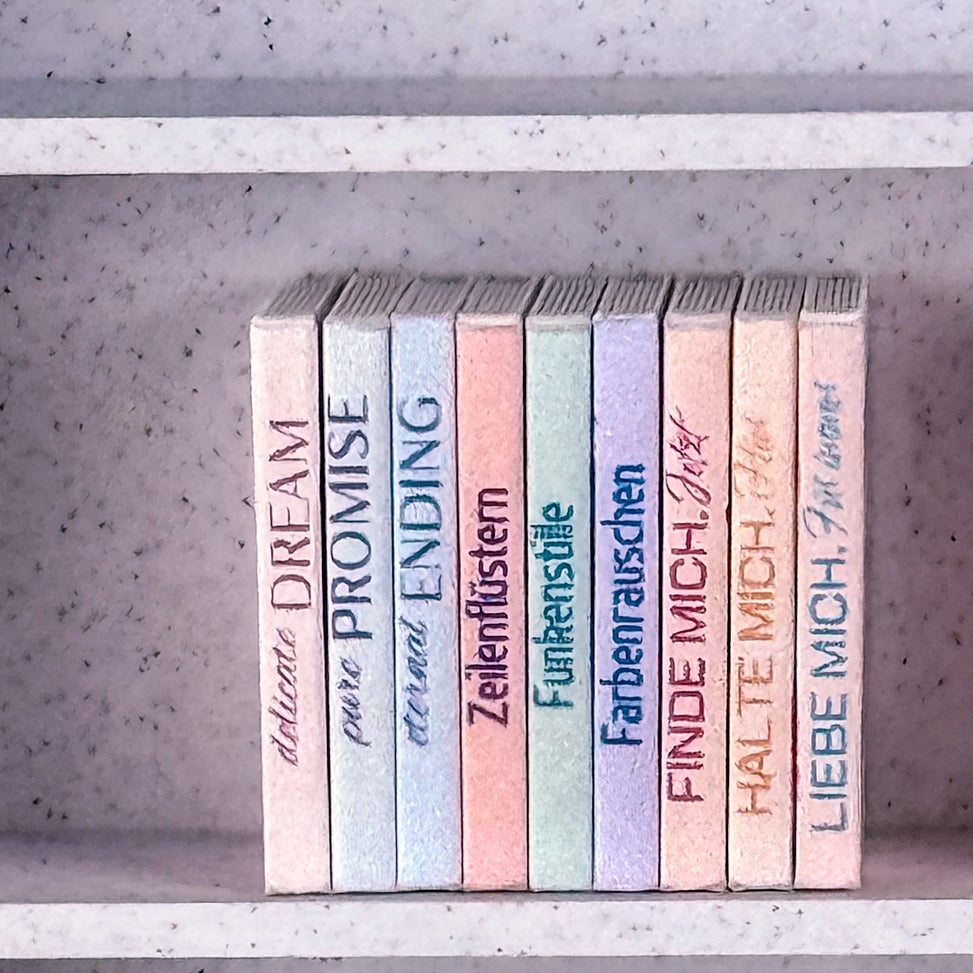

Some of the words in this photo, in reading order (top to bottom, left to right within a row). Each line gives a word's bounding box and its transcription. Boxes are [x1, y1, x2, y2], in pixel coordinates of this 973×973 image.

[269, 419, 312, 612] DREAM
[328, 394, 373, 640] PROMISE
[399, 397, 443, 602] ENDING
[464, 487, 510, 728] Zeilenflüstern
[530, 501, 575, 709] Funkenstille
[599, 463, 646, 746] Farbenrauschen
[665, 656, 706, 802] FINDE
[735, 655, 776, 816] HALTE
[809, 690, 848, 834] LIEBE
